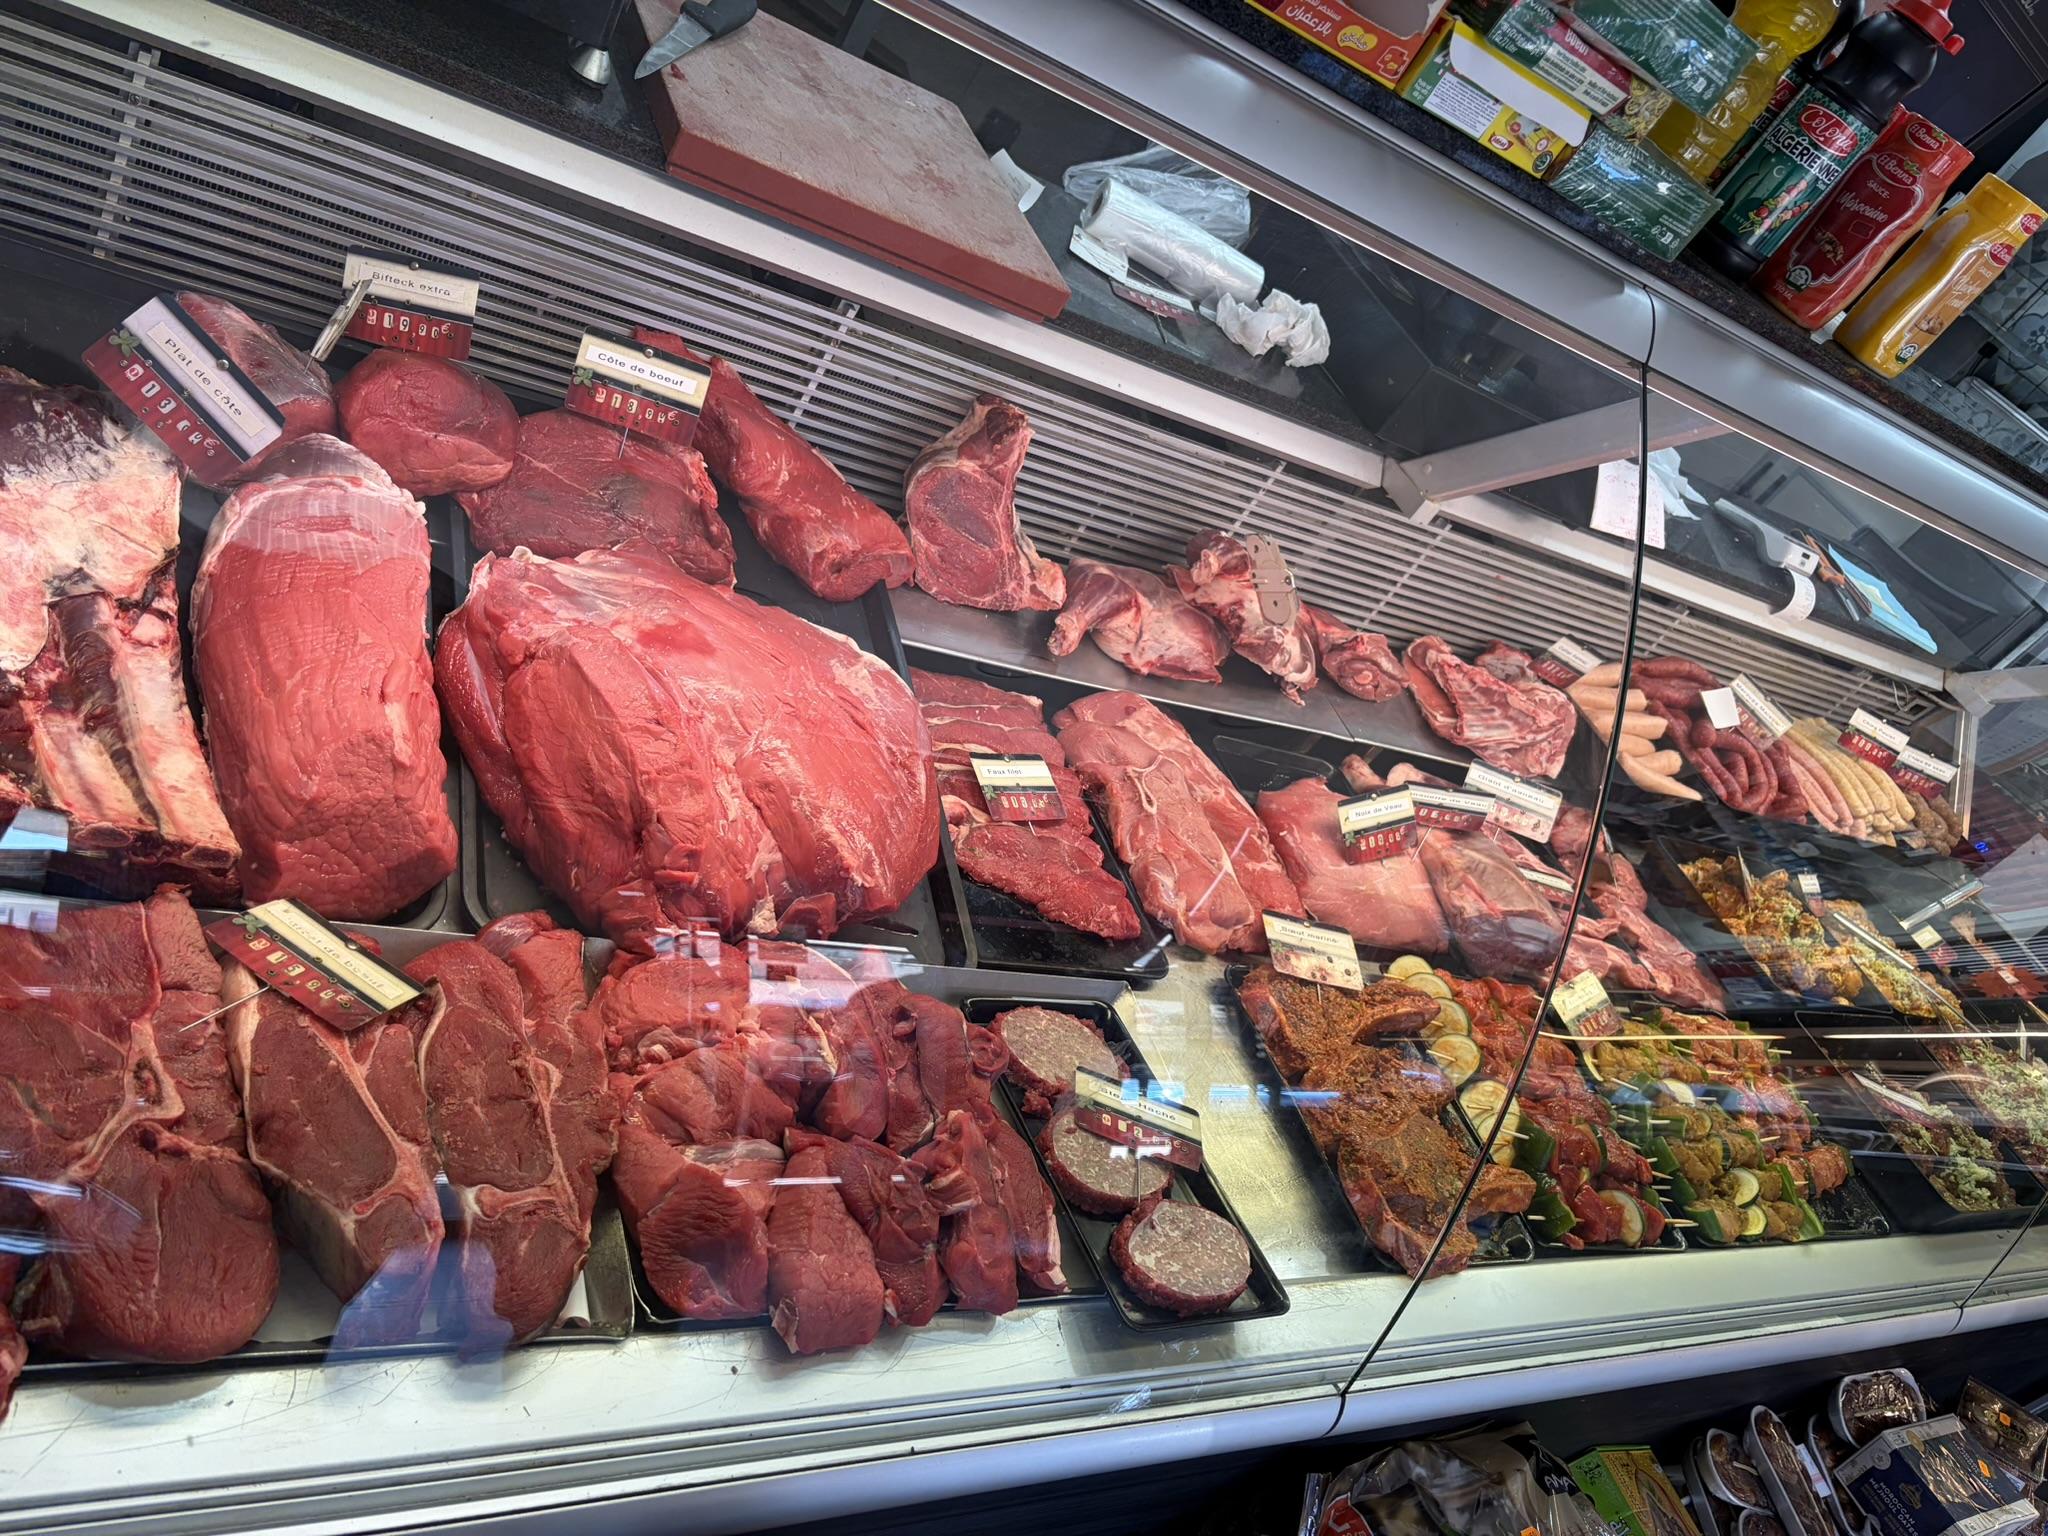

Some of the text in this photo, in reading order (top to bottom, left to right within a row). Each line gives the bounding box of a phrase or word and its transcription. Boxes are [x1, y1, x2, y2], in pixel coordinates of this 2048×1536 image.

[1285, 4, 1333, 38] بالزعفران
[1767, 122, 1842, 184] ALGÉRIENNE
[1884, 160, 1914, 186] Benna
[371, 271, 452, 297] Bifteck extra
[164, 337, 243, 417] Plat de côte
[597, 352, 684, 388] Côte de boeuf
[1354, 802, 1403, 819] Noix de Veau
[1137, 1101, 1177, 1122] Haché
[1879, 1480, 1916, 1526] MOROCCAN
